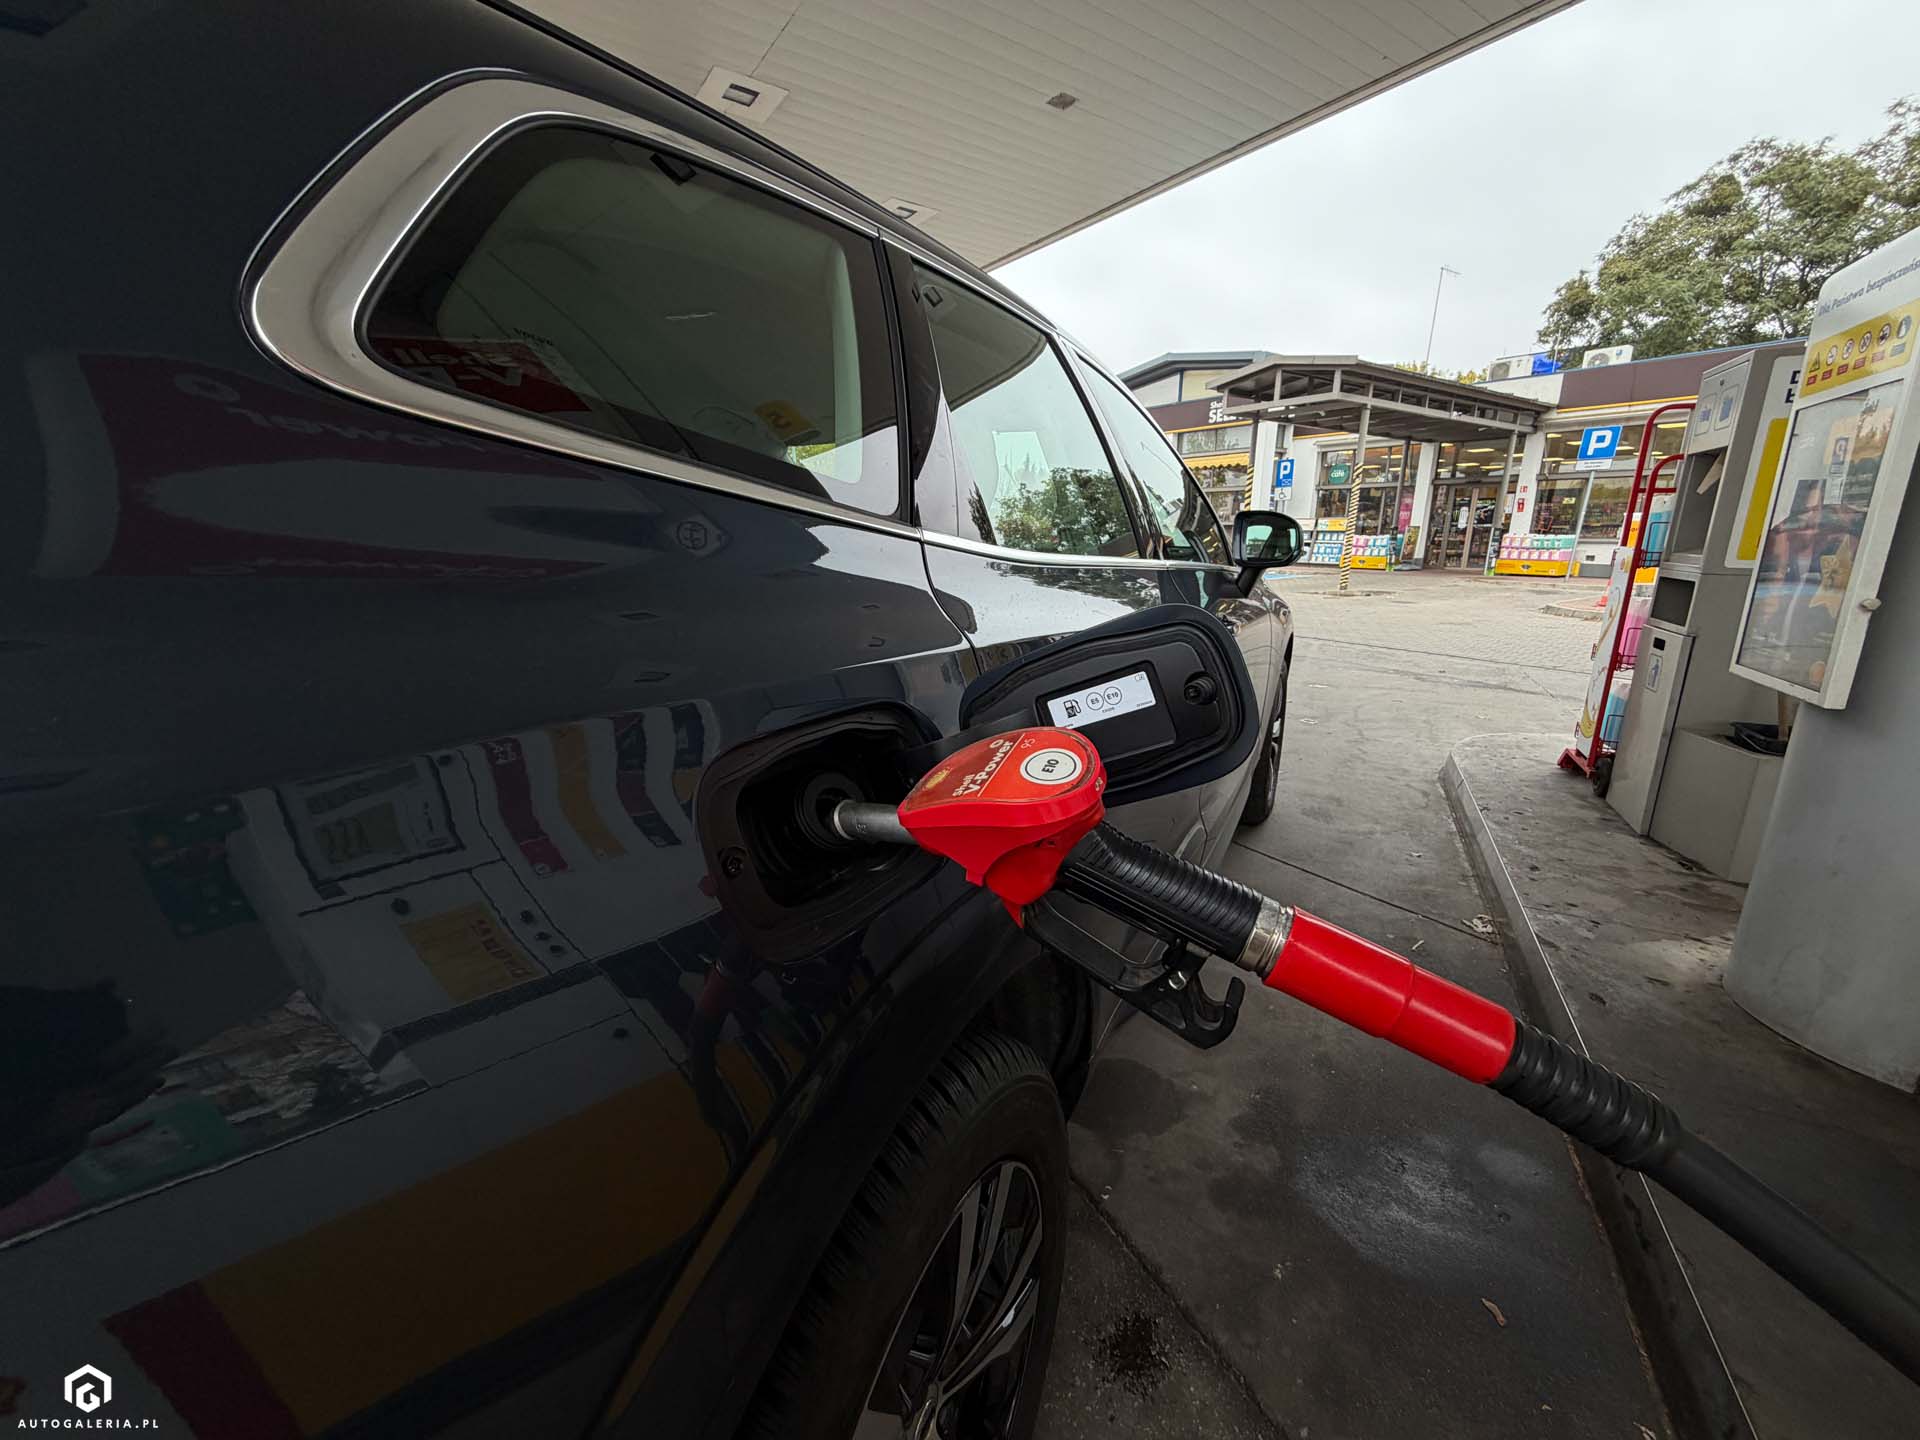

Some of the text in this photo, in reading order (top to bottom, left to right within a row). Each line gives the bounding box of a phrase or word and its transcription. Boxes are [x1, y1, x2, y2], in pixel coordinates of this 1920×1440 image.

[1587, 430, 1612, 456] P
[1280, 461, 1291, 480] P
[1090, 692, 1119, 705] E5 E10
[1020, 738, 1036, 749] 95
[963, 740, 1014, 796] V-Power
[1041, 758, 1060, 774] E10
[952, 774, 976, 797] Shell
